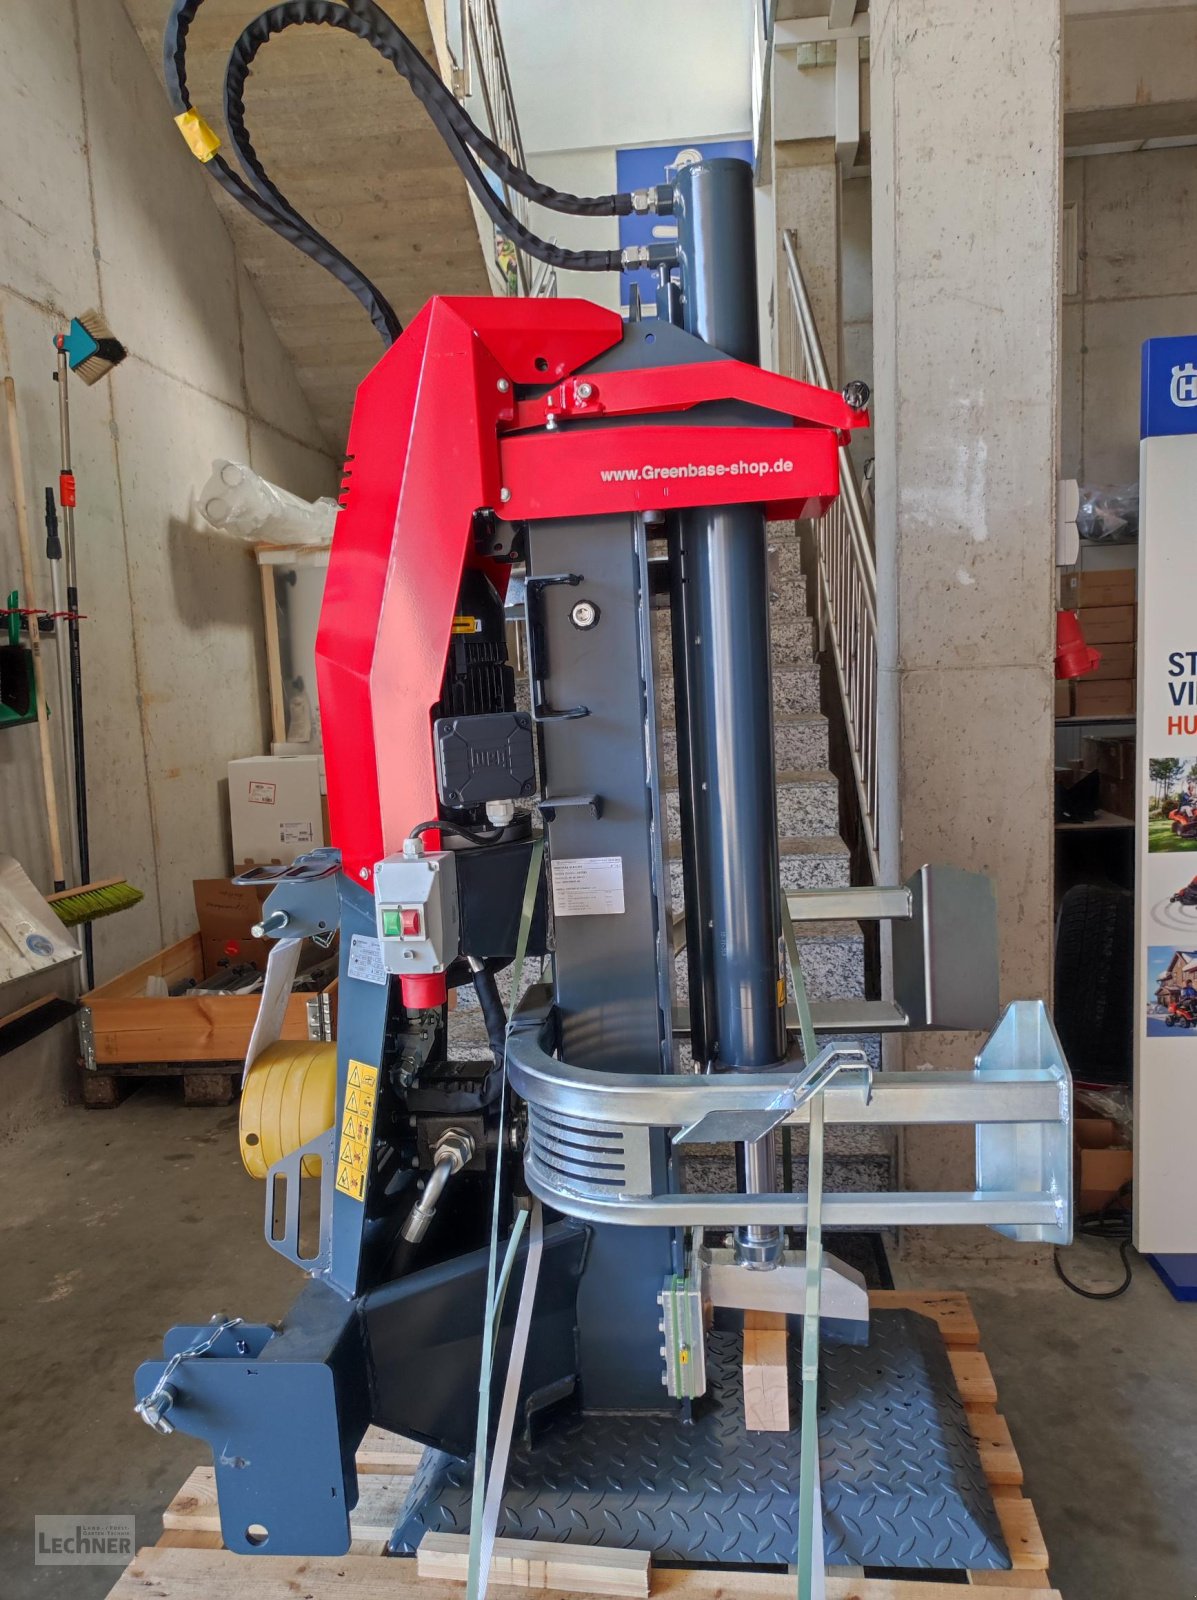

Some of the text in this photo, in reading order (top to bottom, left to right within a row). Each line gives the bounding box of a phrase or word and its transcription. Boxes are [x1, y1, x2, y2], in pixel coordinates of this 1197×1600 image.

[600, 458, 793, 482] www.Greenbase-shop.de
[1168, 681, 1197, 706] VI
[1168, 715, 1197, 736] HU
